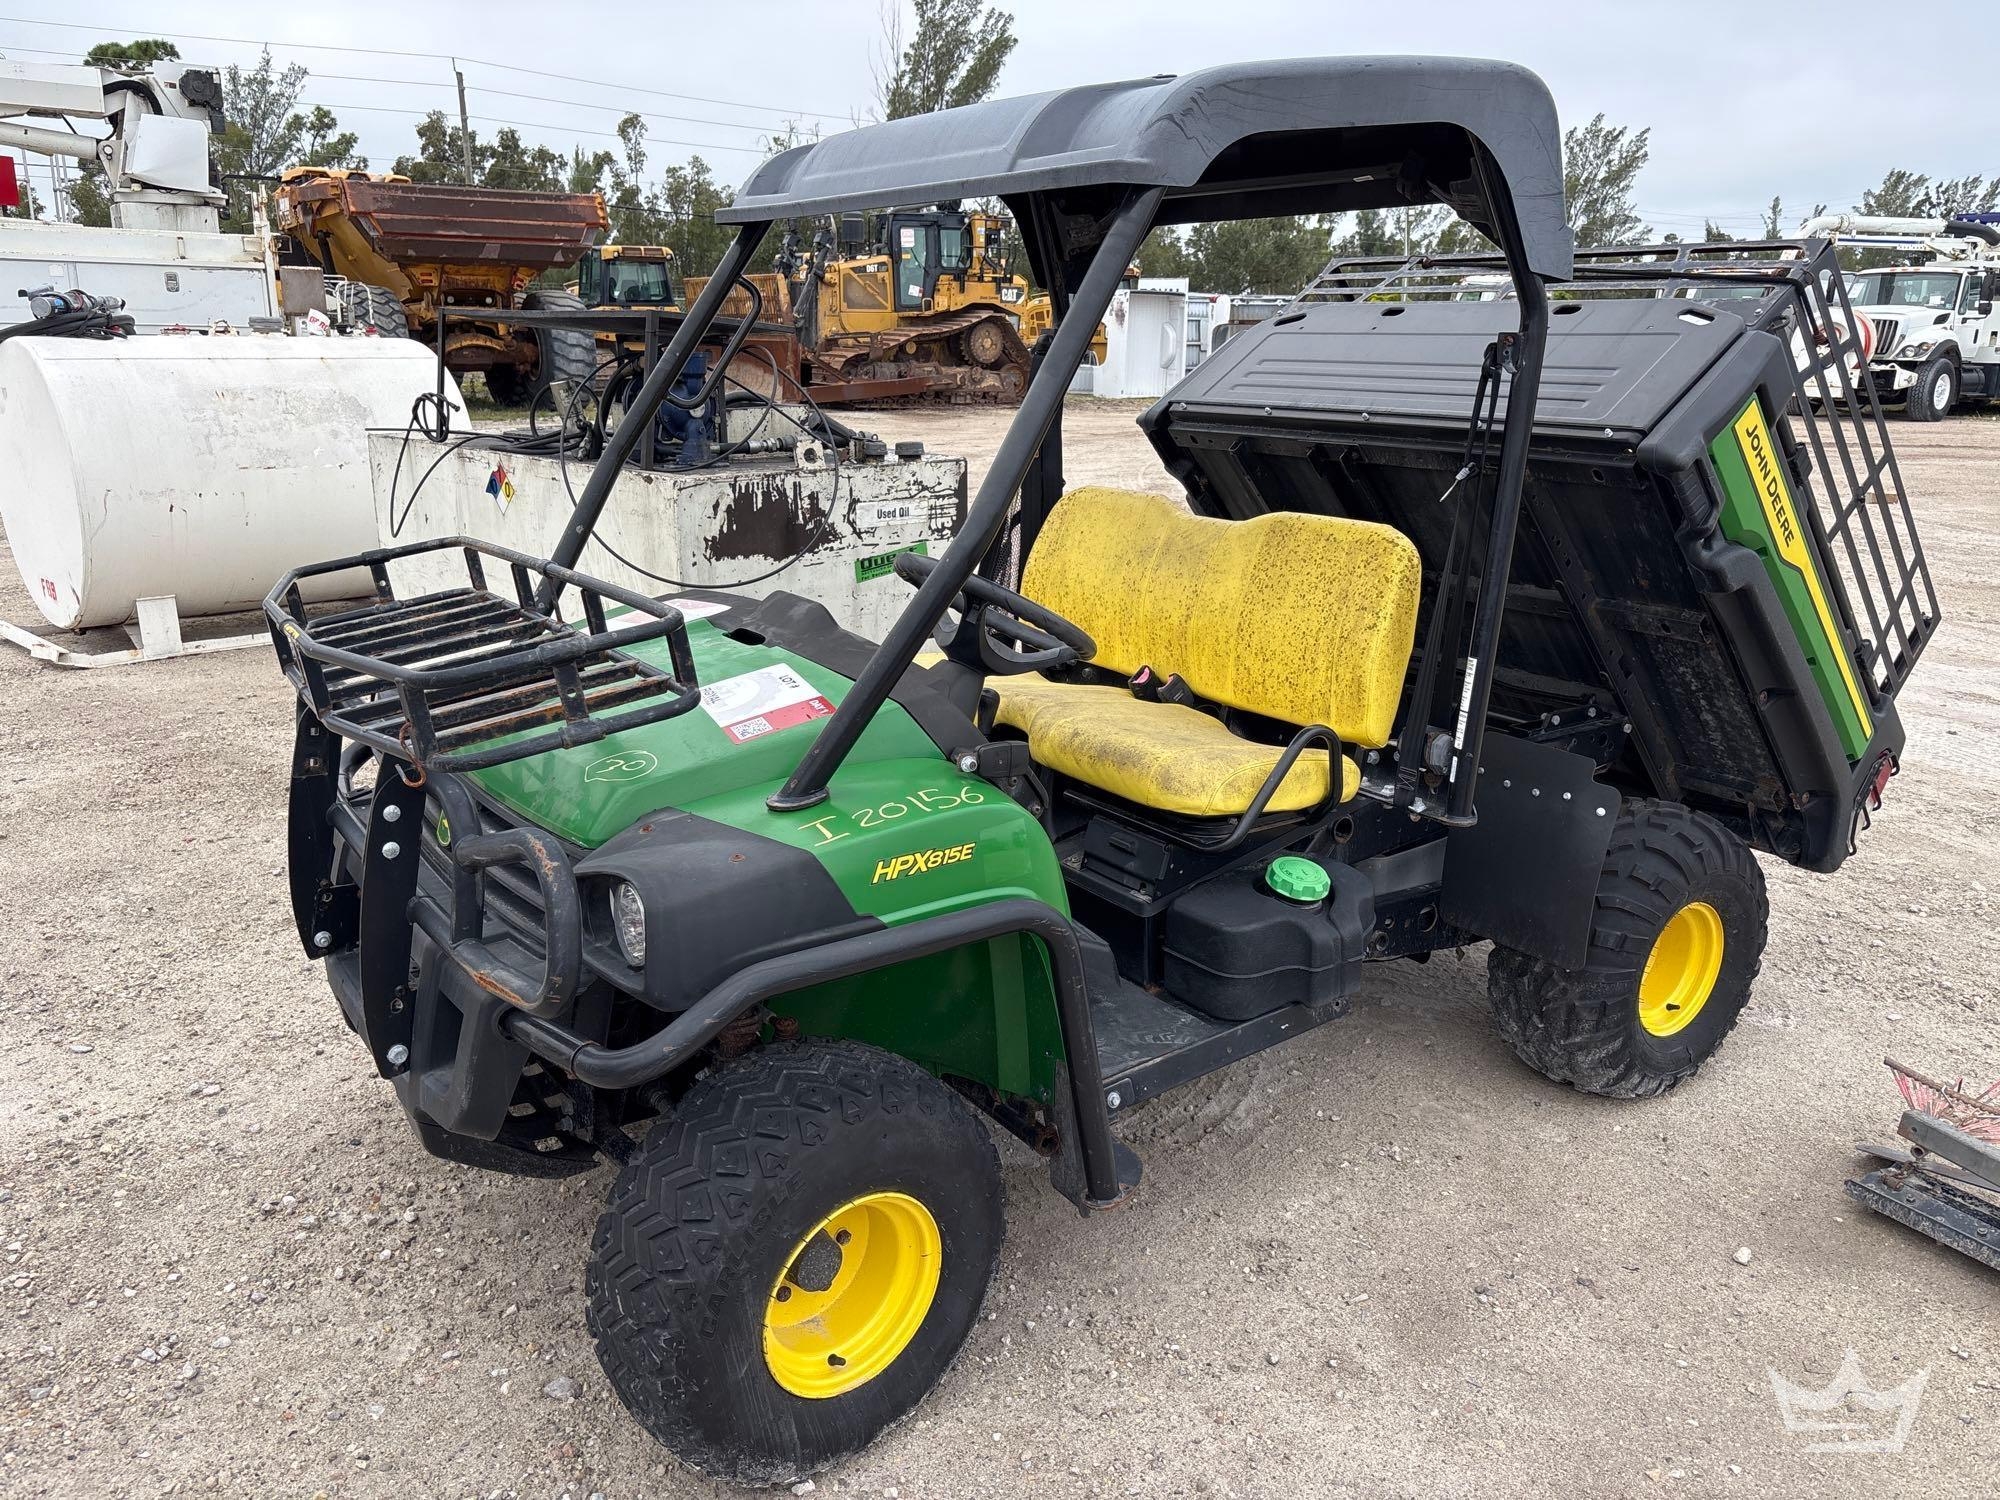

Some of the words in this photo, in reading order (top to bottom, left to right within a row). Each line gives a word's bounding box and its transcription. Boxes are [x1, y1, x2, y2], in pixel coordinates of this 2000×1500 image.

[1001, 288, 1018, 302] CAT
[1745, 424, 1771, 482] JOHN
[1766, 475, 1795, 549] DEERE
[876, 508, 897, 520] Used
[898, 506, 910, 518] Oil
[778, 674, 797, 686] LOT
[808, 699, 827, 712] DAY
[851, 785, 985, 828] 20156
[871, 842, 977, 886] HPX815E
